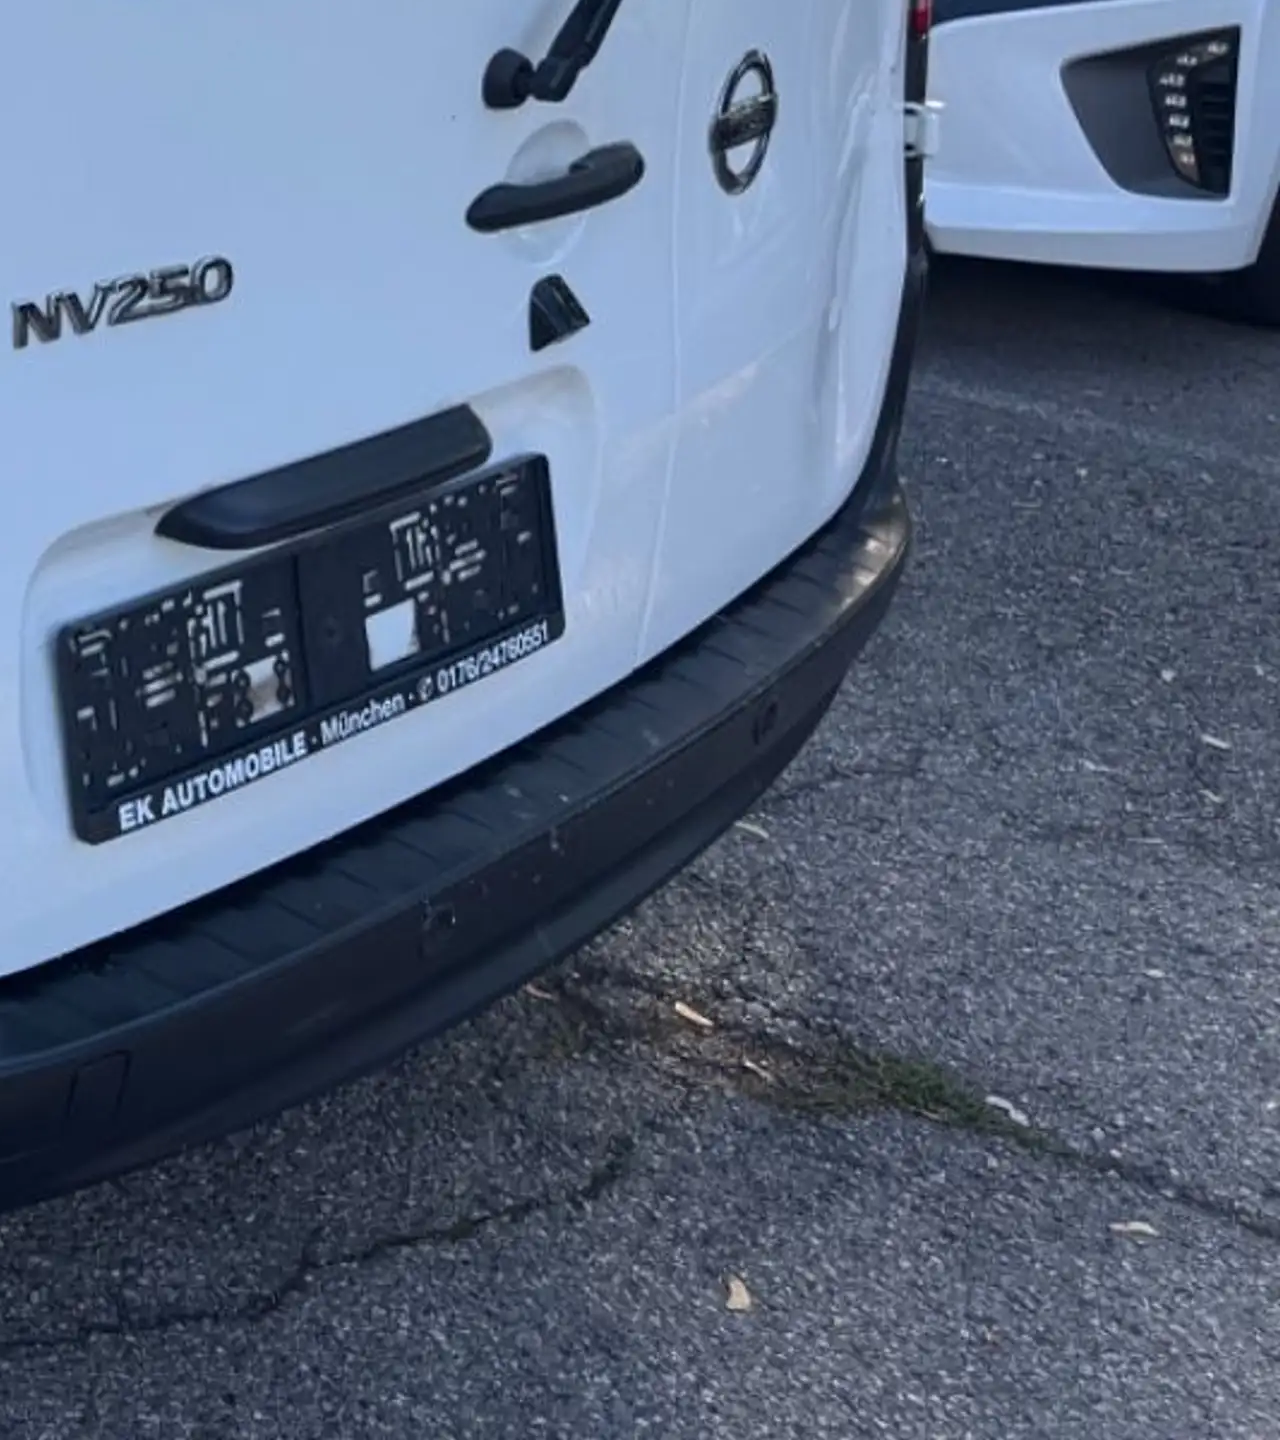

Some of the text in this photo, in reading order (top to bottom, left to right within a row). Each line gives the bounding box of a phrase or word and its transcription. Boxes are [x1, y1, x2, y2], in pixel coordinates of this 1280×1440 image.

[11, 254, 234, 350] NV250
[118, 793, 156, 831] EK
[161, 730, 308, 815] AUTOMOBILE
[319, 691, 406, 745] München
